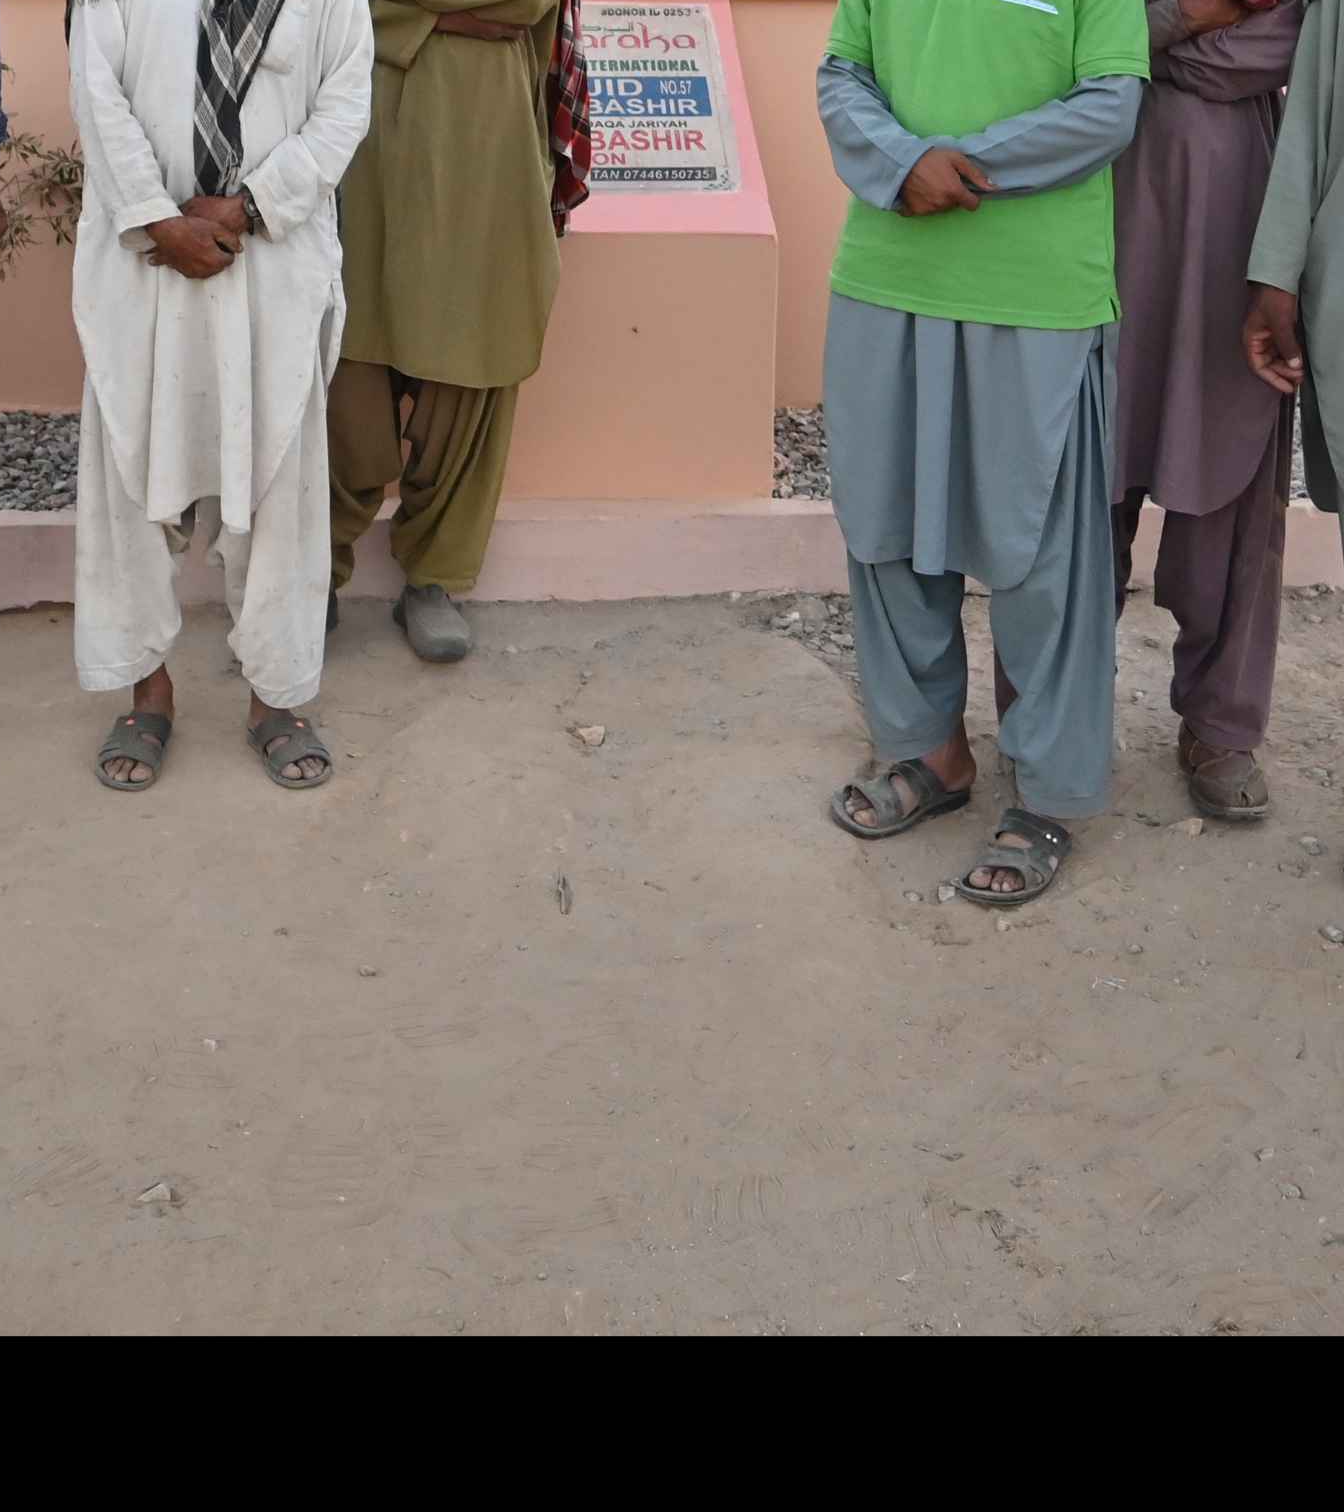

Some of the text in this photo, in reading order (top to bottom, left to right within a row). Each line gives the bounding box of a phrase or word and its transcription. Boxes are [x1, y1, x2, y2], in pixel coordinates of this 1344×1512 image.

[587, 59, 699, 72] TERNATIONAL
[588, 79, 643, 96] JID
[588, 98, 699, 115] BASHIR
[591, 130, 706, 151] BASHIR
